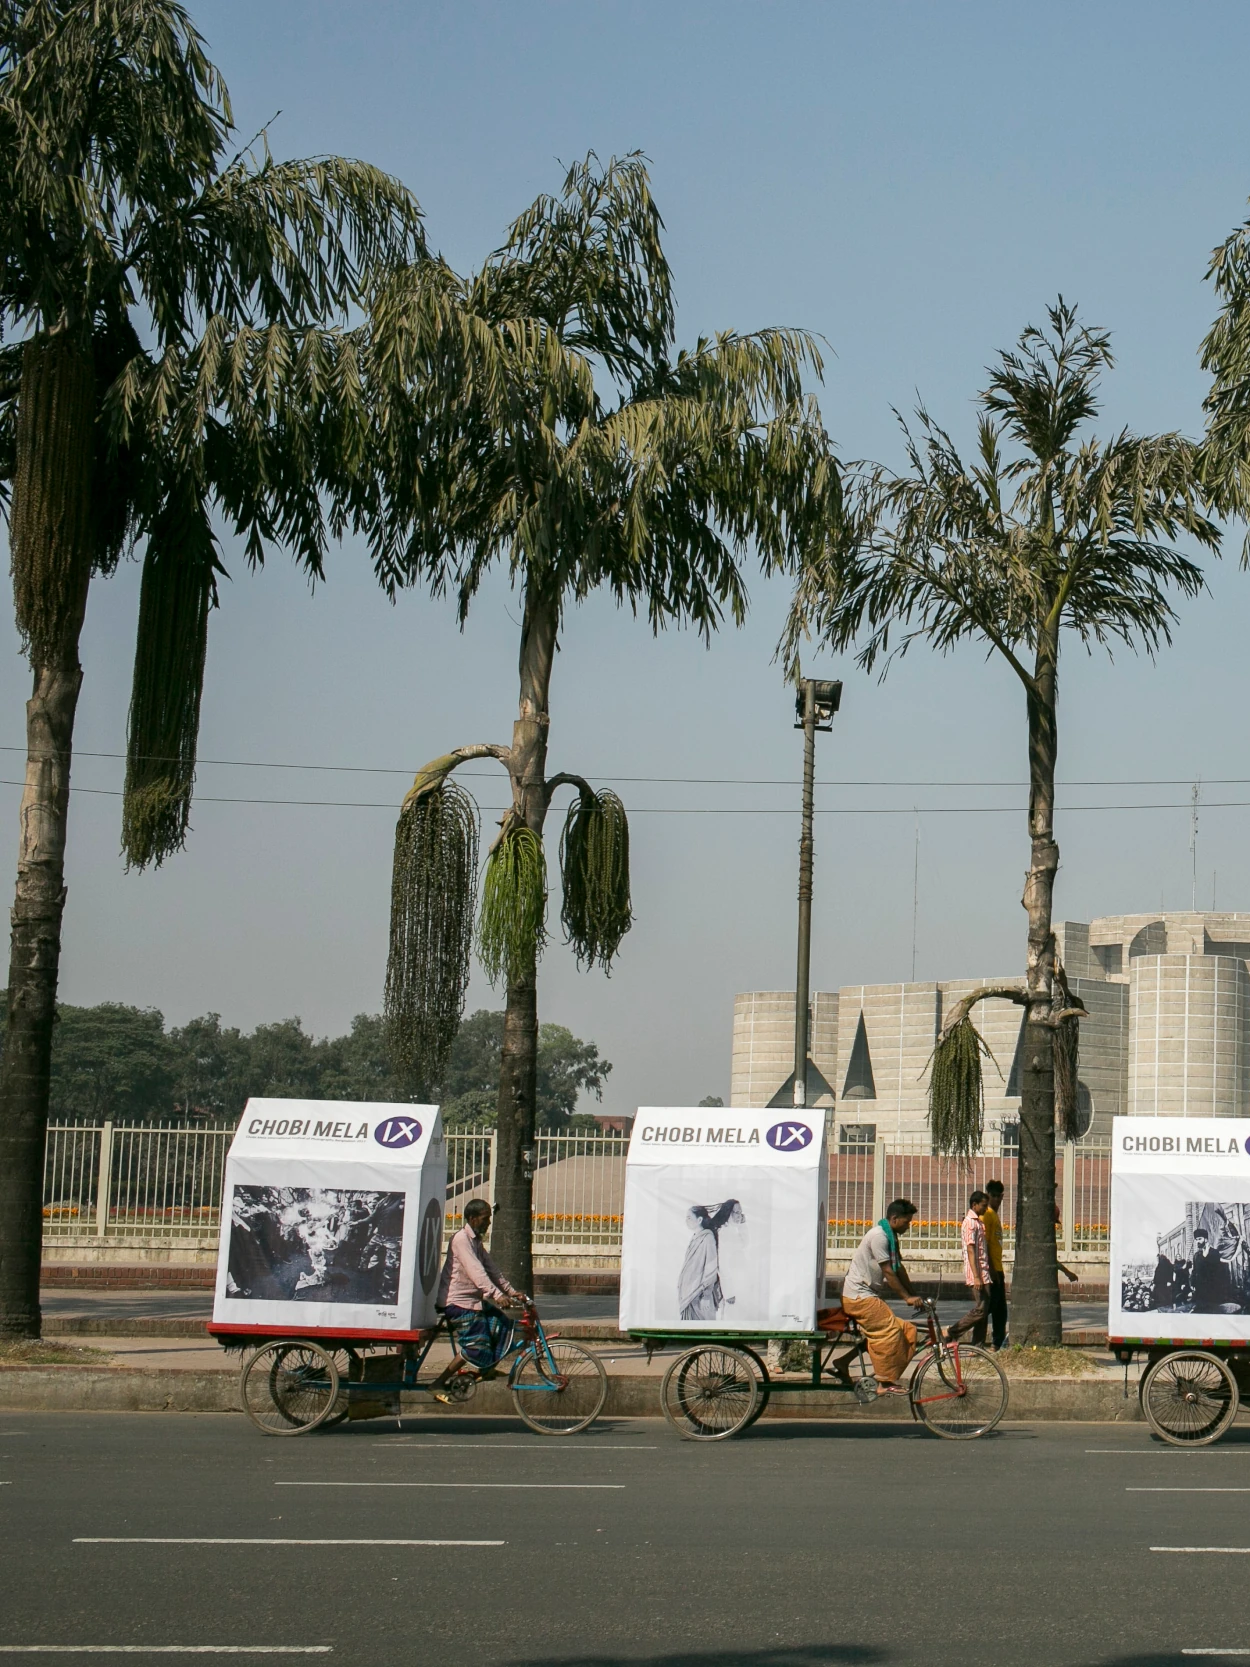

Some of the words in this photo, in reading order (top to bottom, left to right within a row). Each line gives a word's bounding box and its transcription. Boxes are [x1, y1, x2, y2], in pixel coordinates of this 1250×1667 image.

[248, 1119, 311, 1136] CHOBI
[312, 1120, 369, 1139] MELA
[382, 1121, 417, 1142] IX
[641, 1126, 702, 1143] CHOBI
[706, 1127, 760, 1144] MELA
[774, 1126, 807, 1146] IX
[1122, 1136, 1180, 1152] CHOBI
[1186, 1137, 1240, 1153] MELA
[423, 1217, 440, 1277] IX
